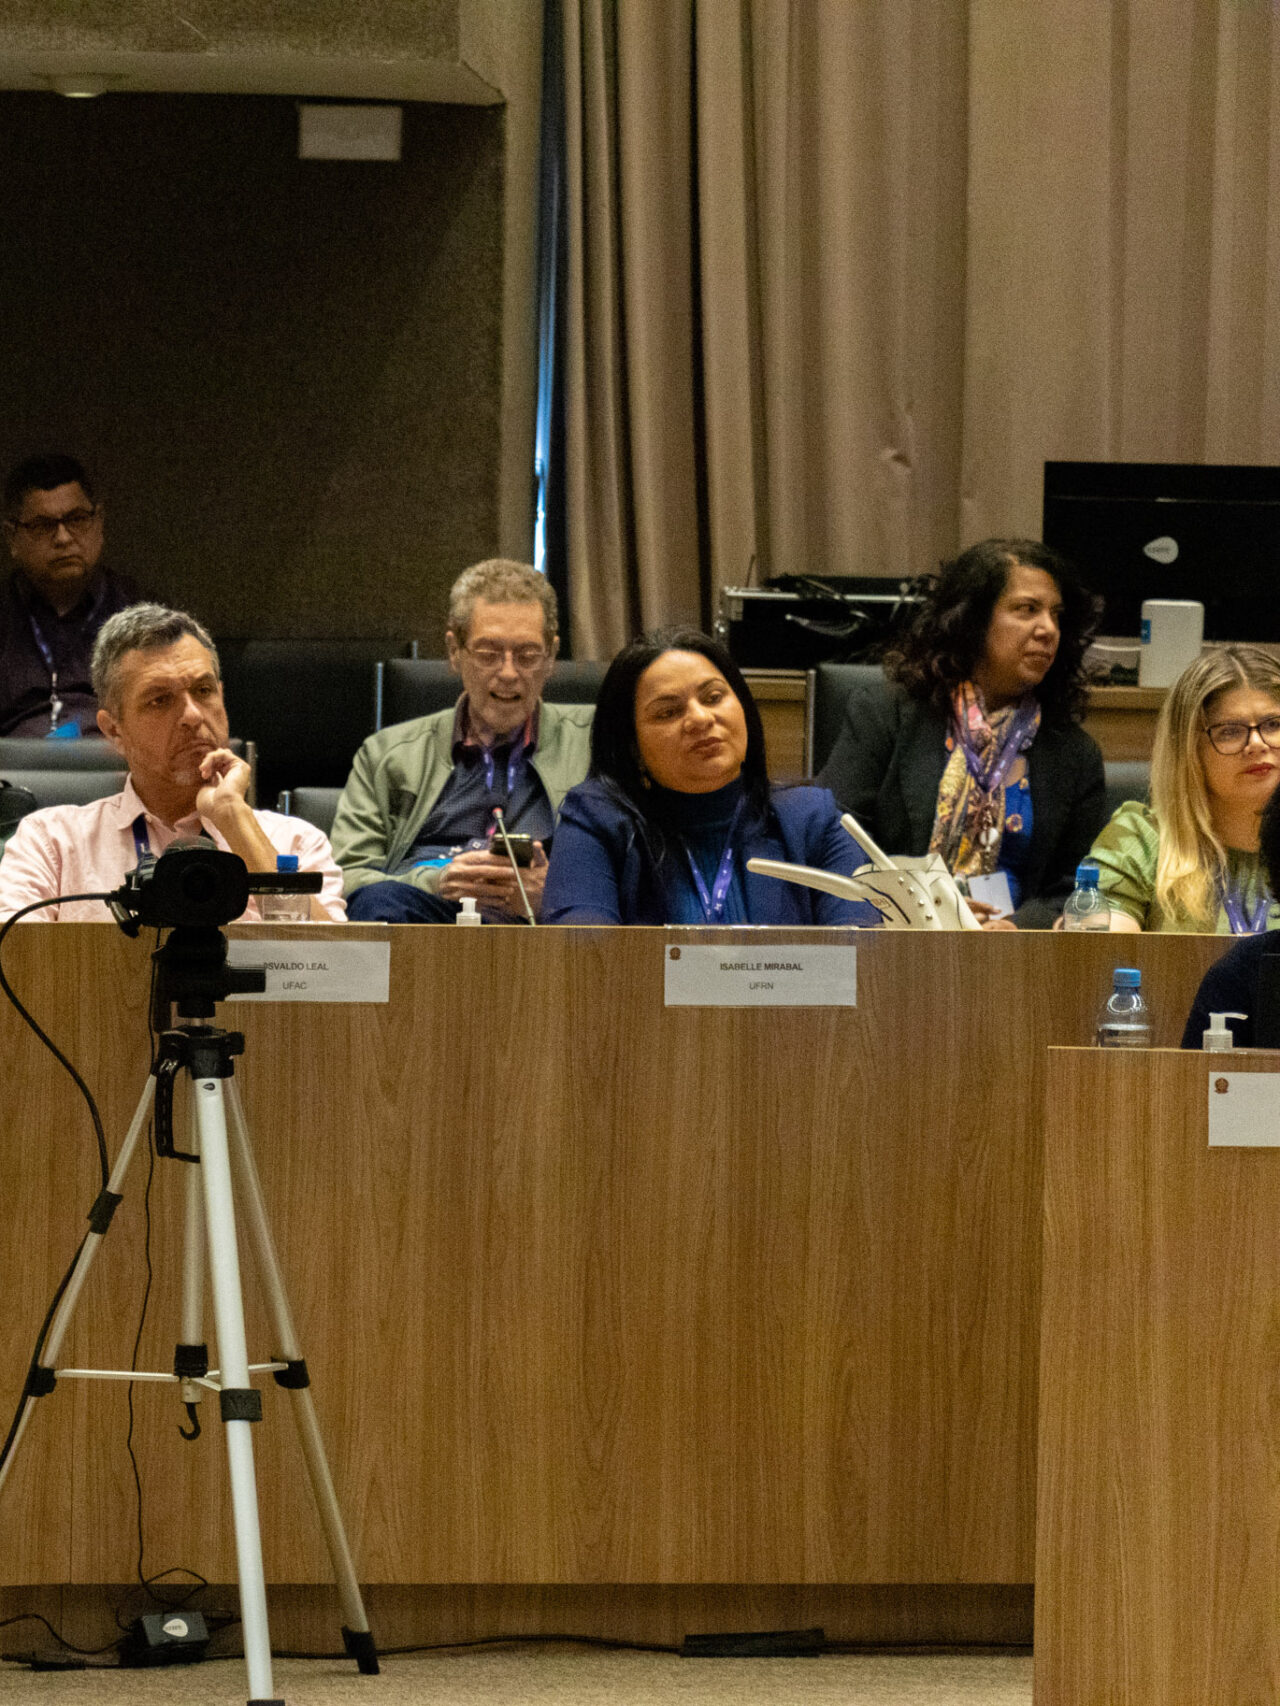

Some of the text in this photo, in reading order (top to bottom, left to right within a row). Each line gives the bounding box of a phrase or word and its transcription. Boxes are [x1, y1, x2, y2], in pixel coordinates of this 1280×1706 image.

[306, 962, 329, 970] LEAL
[720, 962, 803, 971] ISABELLE MIRABAL
[282, 981, 307, 990] UFAC
[749, 982, 774, 990] UFRN
